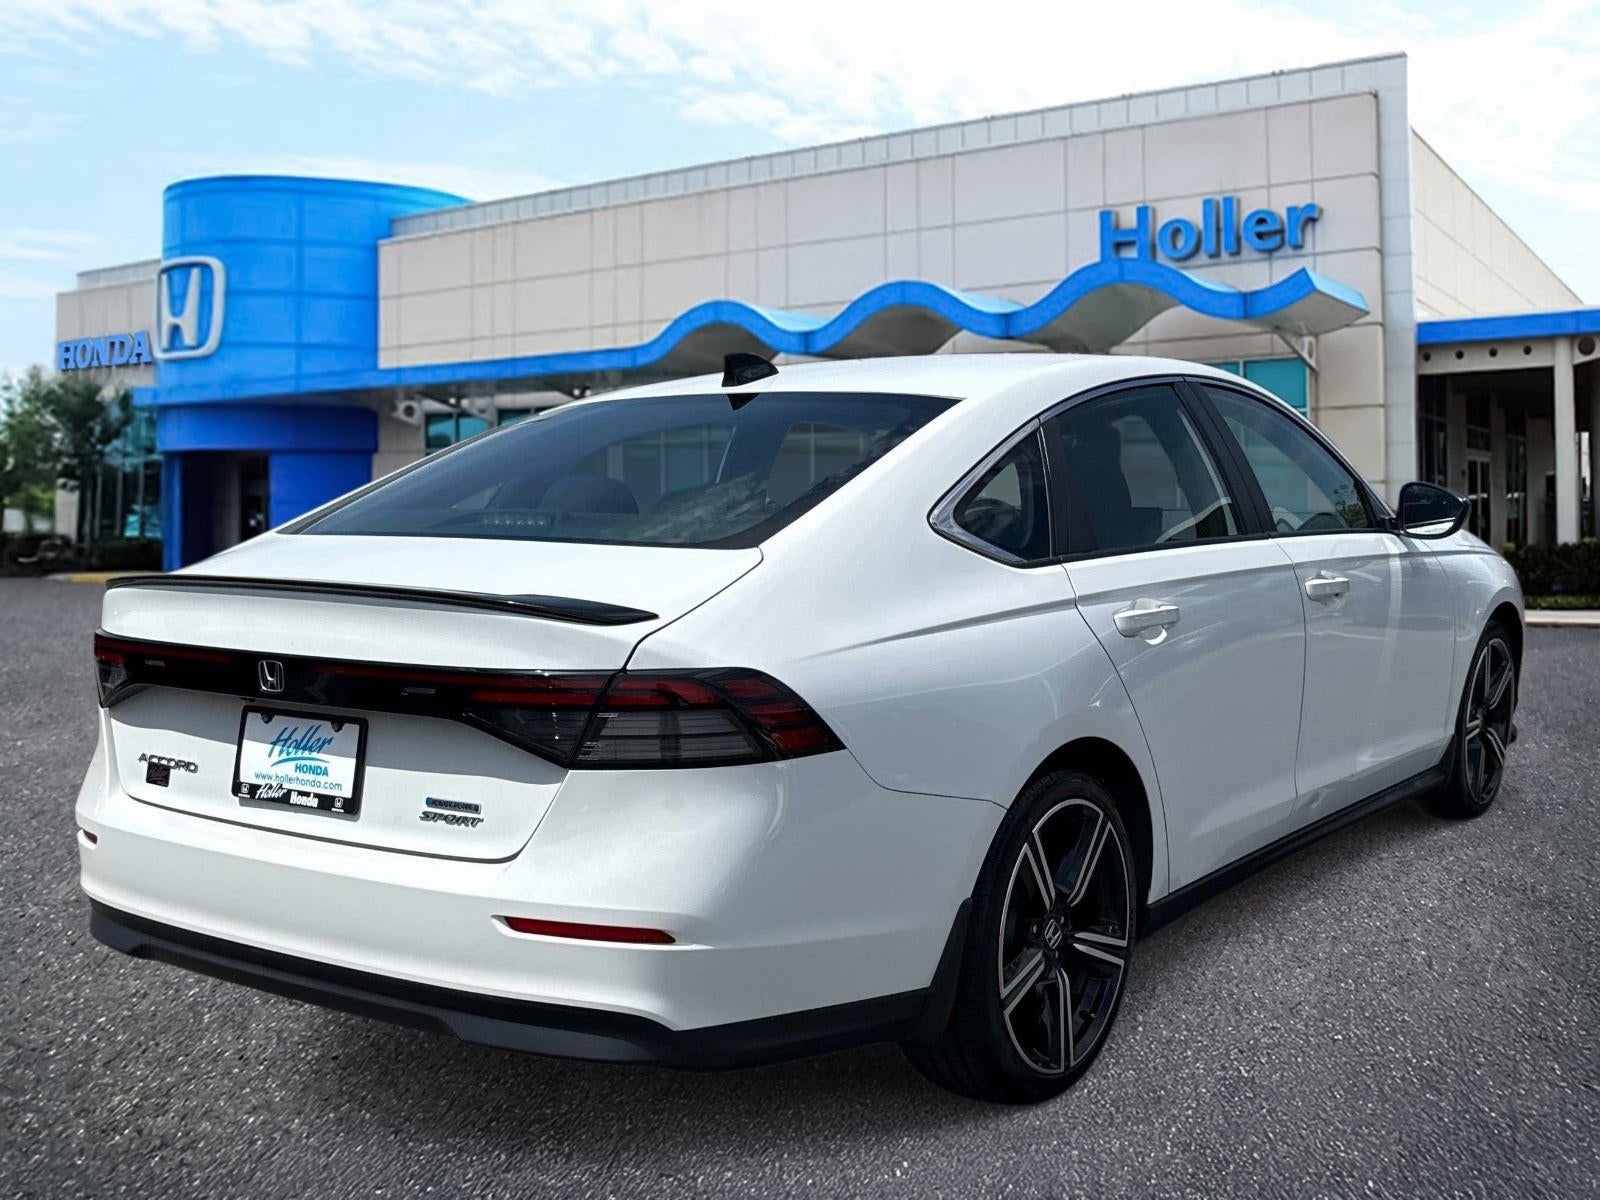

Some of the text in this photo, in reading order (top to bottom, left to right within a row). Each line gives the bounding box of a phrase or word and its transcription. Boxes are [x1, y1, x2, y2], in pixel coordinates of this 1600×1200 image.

[1099, 195, 1322, 262] Holler
[57, 331, 153, 371] HONDA
[267, 724, 334, 758] Holler
[138, 752, 199, 774] ACCORD
[294, 762, 329, 777] HONDA
[254, 771, 342, 791] www.hollerhonda.com
[255, 783, 319, 808] Holler Honda
[419, 810, 484, 828] SPORT
